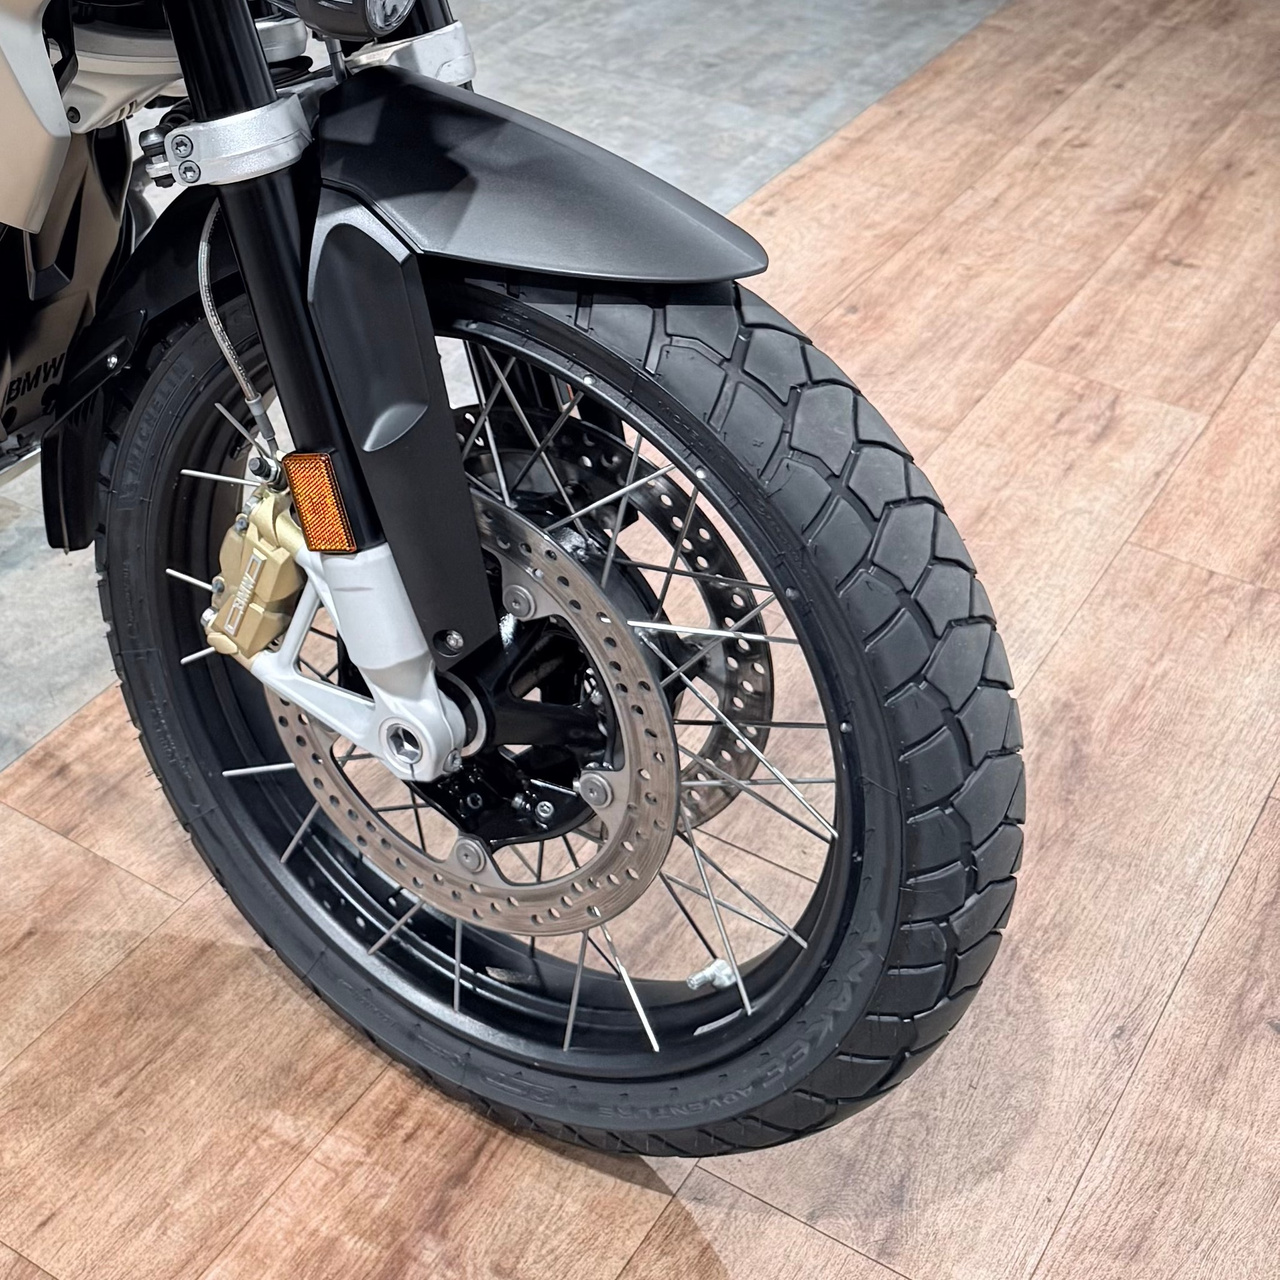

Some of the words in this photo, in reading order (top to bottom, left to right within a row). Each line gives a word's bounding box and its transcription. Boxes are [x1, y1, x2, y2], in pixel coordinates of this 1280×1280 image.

[5, 352, 66, 405] BMW
[232, 571, 257, 615] BMW
[599, 1085, 754, 1120] ADVENTURE
